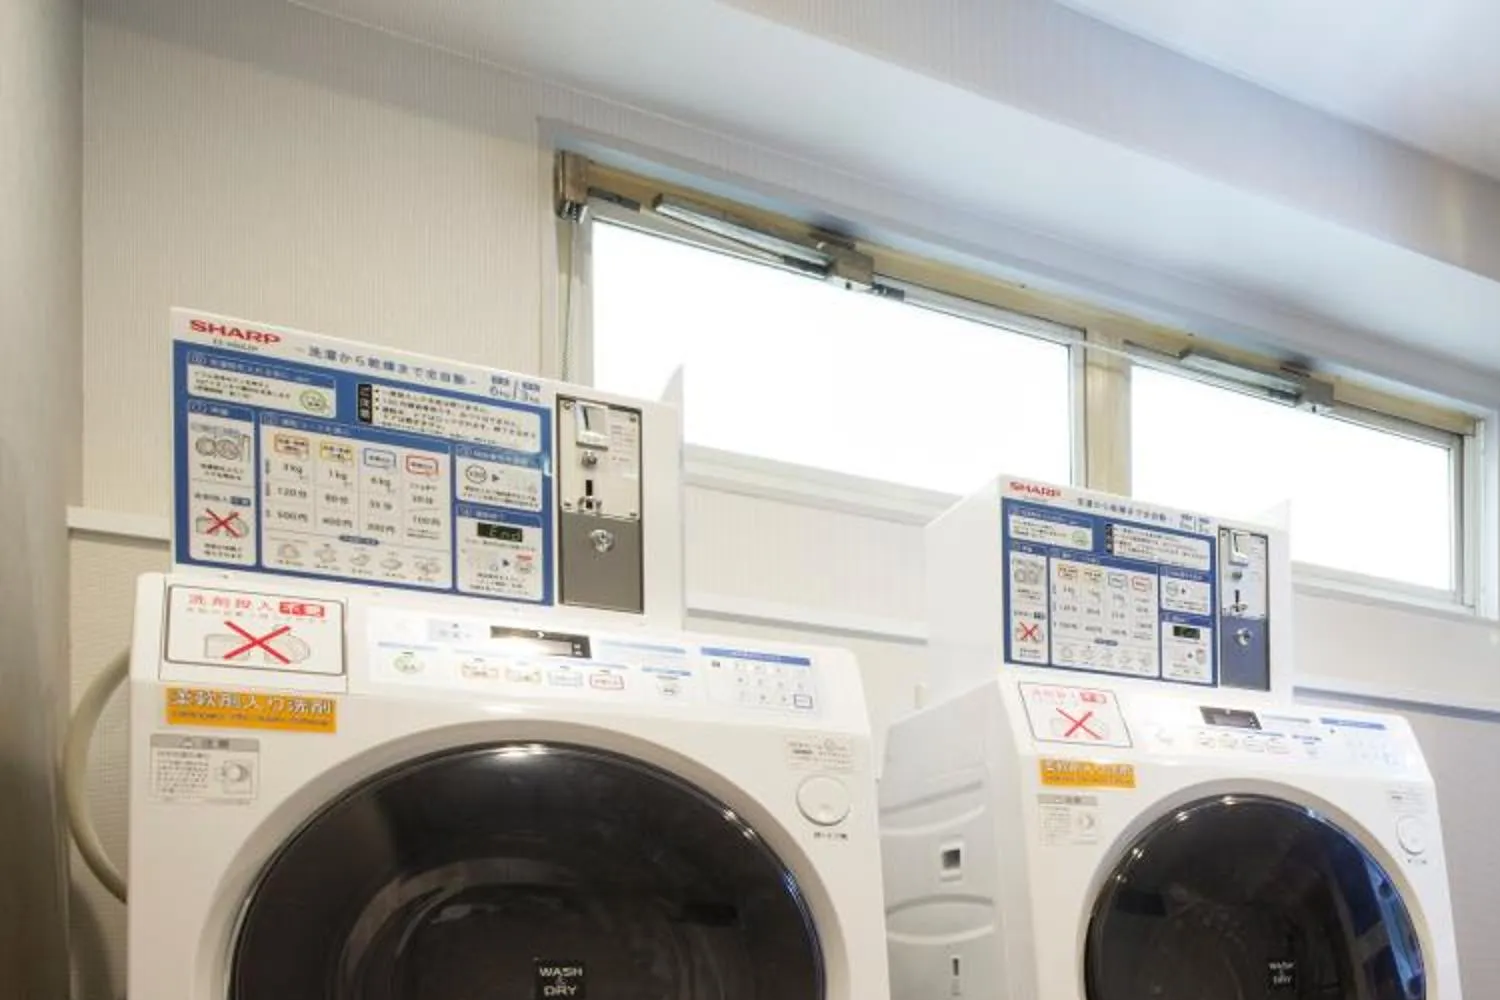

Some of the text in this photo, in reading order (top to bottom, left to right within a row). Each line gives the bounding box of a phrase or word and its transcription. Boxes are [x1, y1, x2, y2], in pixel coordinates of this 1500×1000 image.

[190, 319, 282, 344] SHARP
[1009, 481, 1062, 497] SHARP
[540, 967, 582, 977] WASH
[544, 986, 576, 997] DRY
